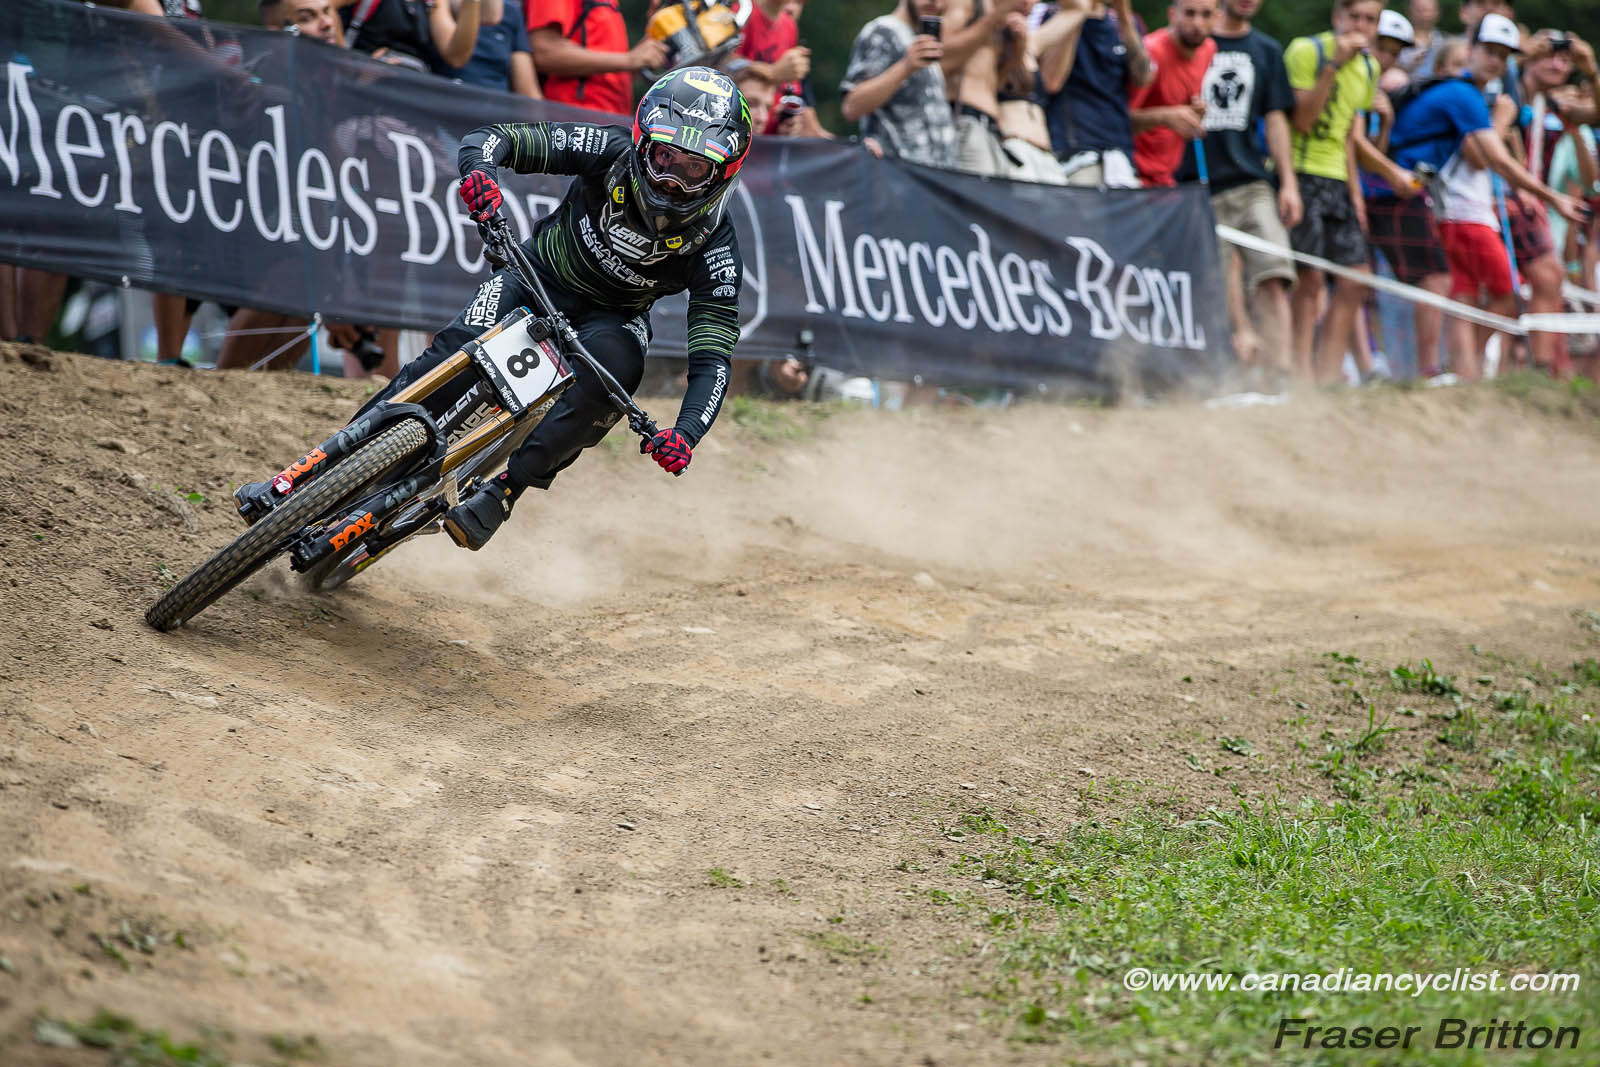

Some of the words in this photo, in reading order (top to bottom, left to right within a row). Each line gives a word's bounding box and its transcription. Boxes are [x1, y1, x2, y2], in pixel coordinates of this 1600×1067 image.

[608, 223, 652, 247] LEATT
[706, 255, 716, 264] DT
[785, 195, 1206, 350] Mercedes-Benz
[484, 275, 503, 328] MADISON
[507, 348, 540, 378] 8
[706, 365, 726, 420] MADISON
[329, 511, 376, 552] FOX
